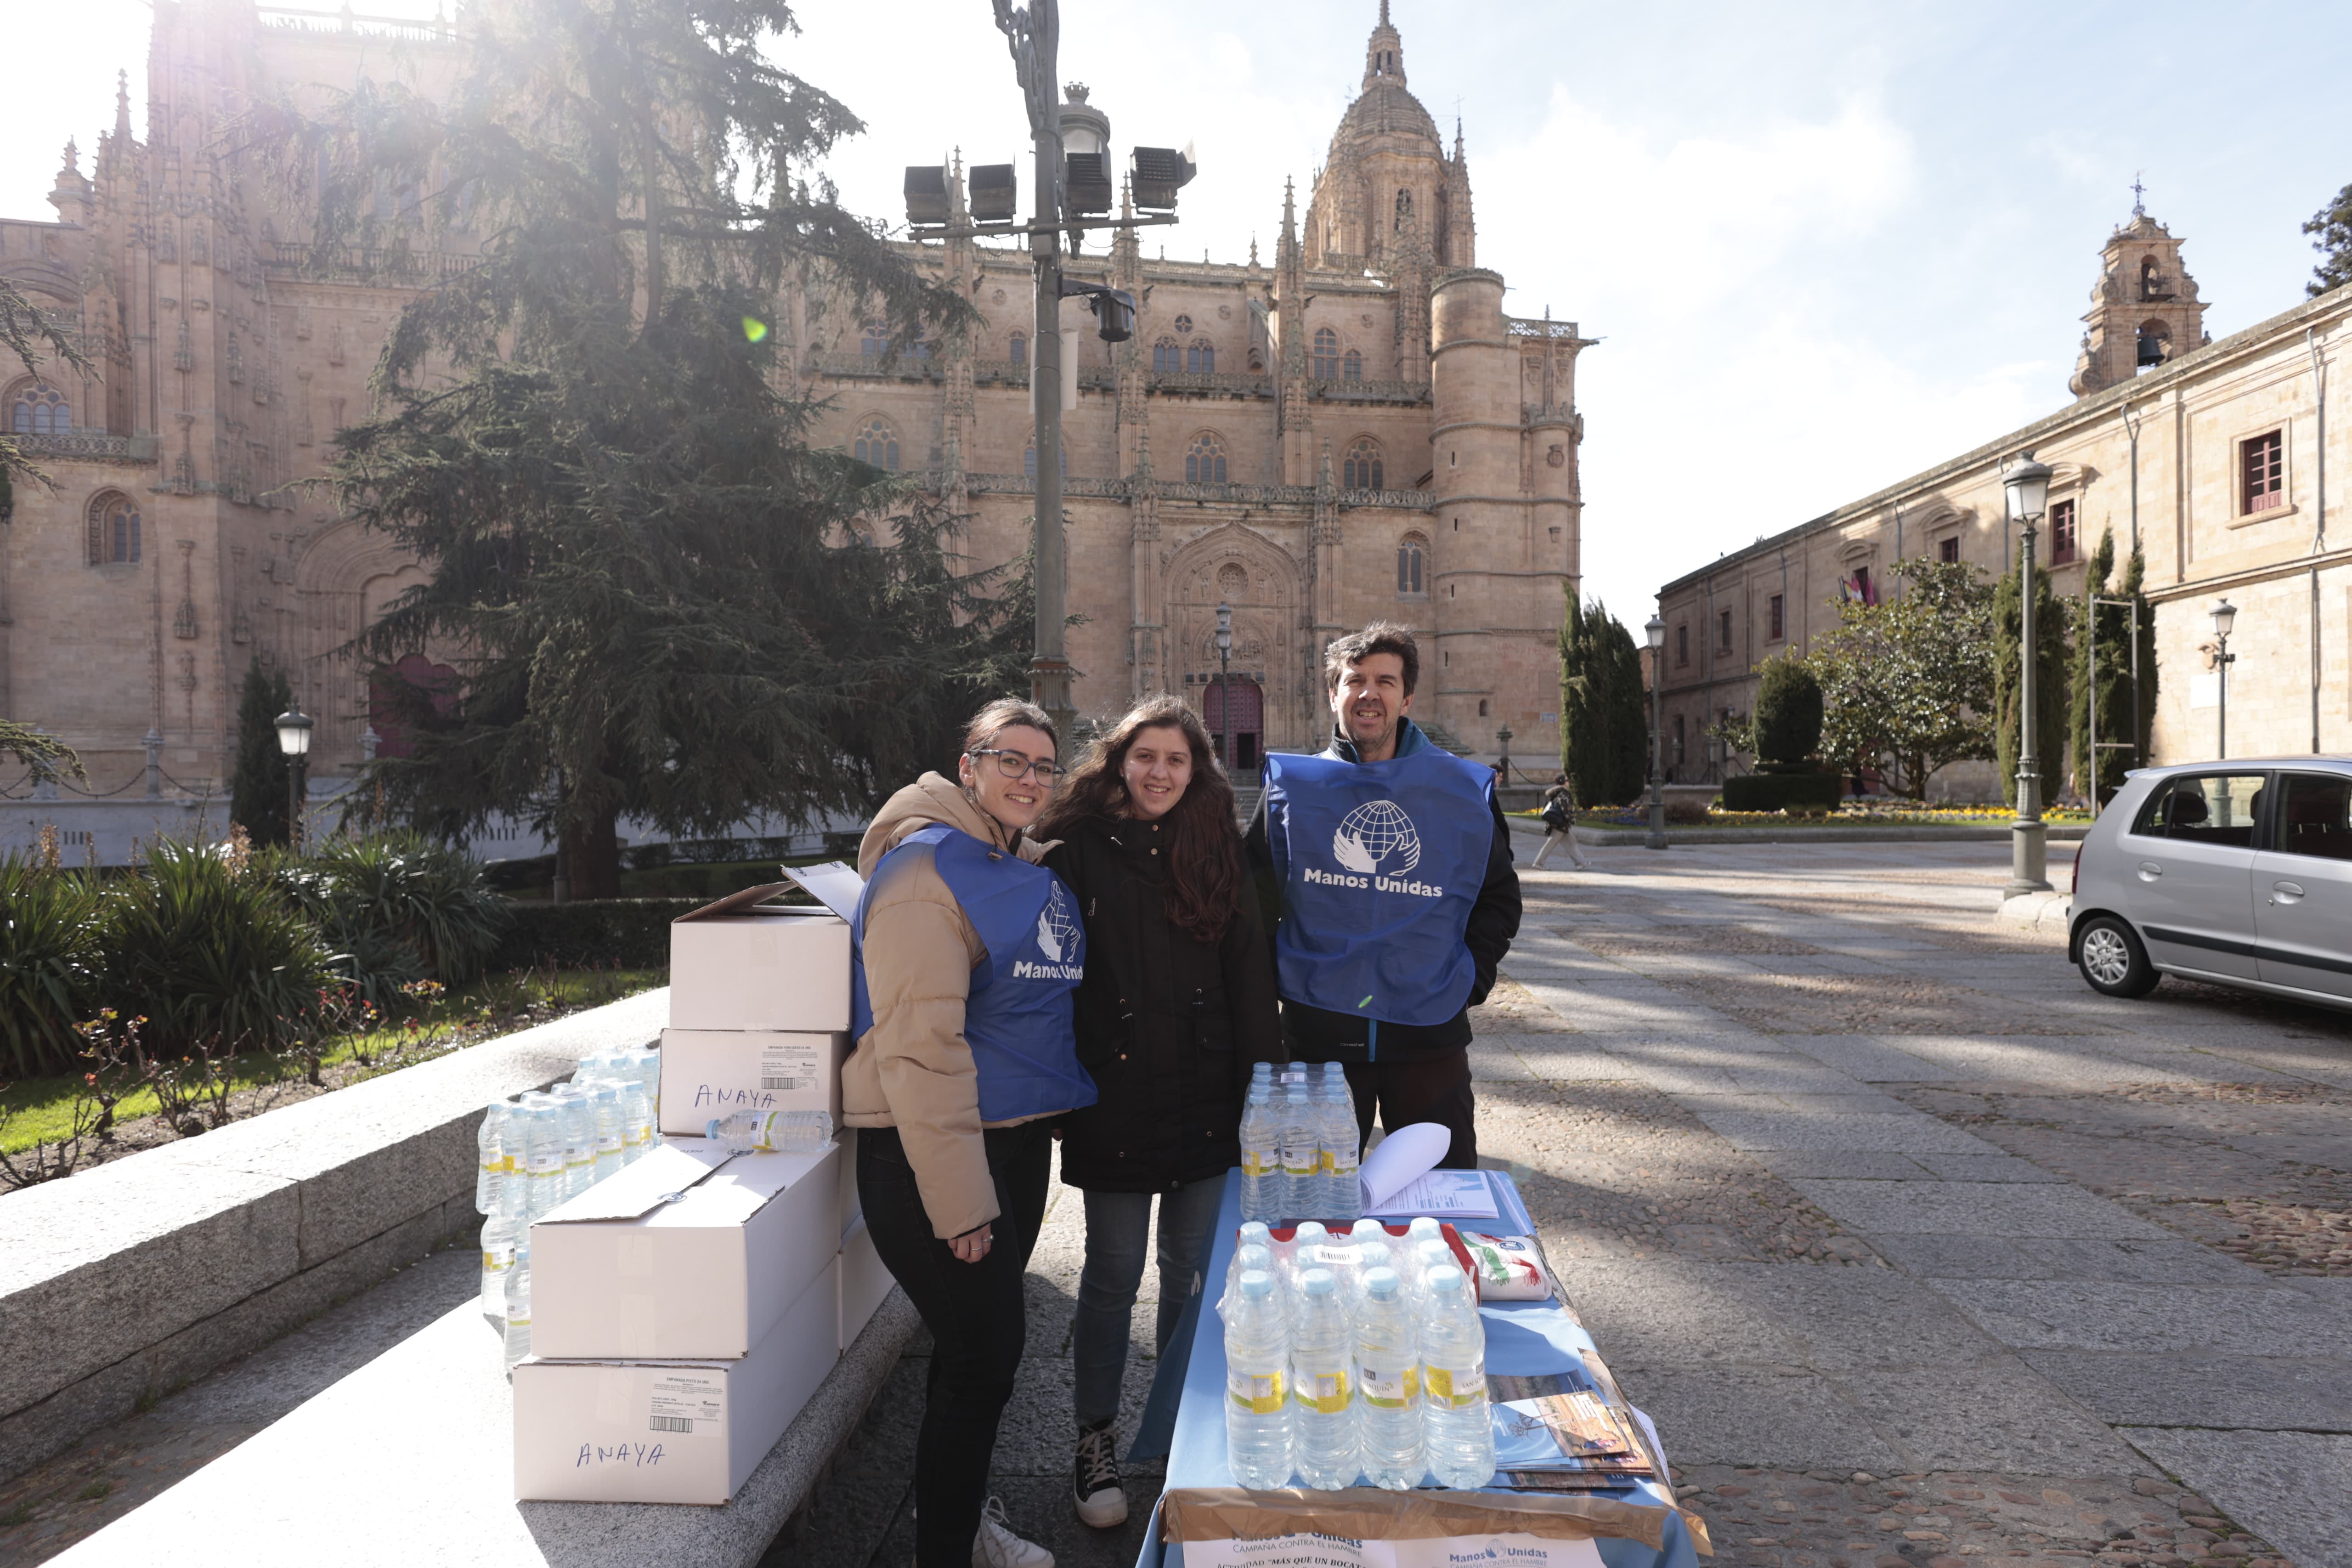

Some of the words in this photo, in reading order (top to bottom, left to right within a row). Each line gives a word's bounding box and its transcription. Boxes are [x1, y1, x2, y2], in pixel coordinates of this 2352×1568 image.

[1304, 868, 1368, 889] Manos
[1375, 876, 1442, 897] Unidas
[1013, 961, 1062, 979] Manos
[1060, 965, 1083, 980] Unid
[695, 1084, 777, 1109] ANAYA
[577, 1443, 666, 1467] ANAYA
[1233, 1542, 1276, 1553] CAMPAÑA
[1279, 1539, 1315, 1549] CONTRA
[1328, 1543, 1362, 1558] HAMBRE
[1449, 1552, 1485, 1562] Manos
[1507, 1548, 1548, 1558] Unidas
[1294, 1556, 1312, 1565] QUE
[1330, 1559, 1367, 1568] BOCAT
[1484, 1558, 1510, 1568] CONTRA
[1521, 1558, 1548, 1567] HAMBRE
